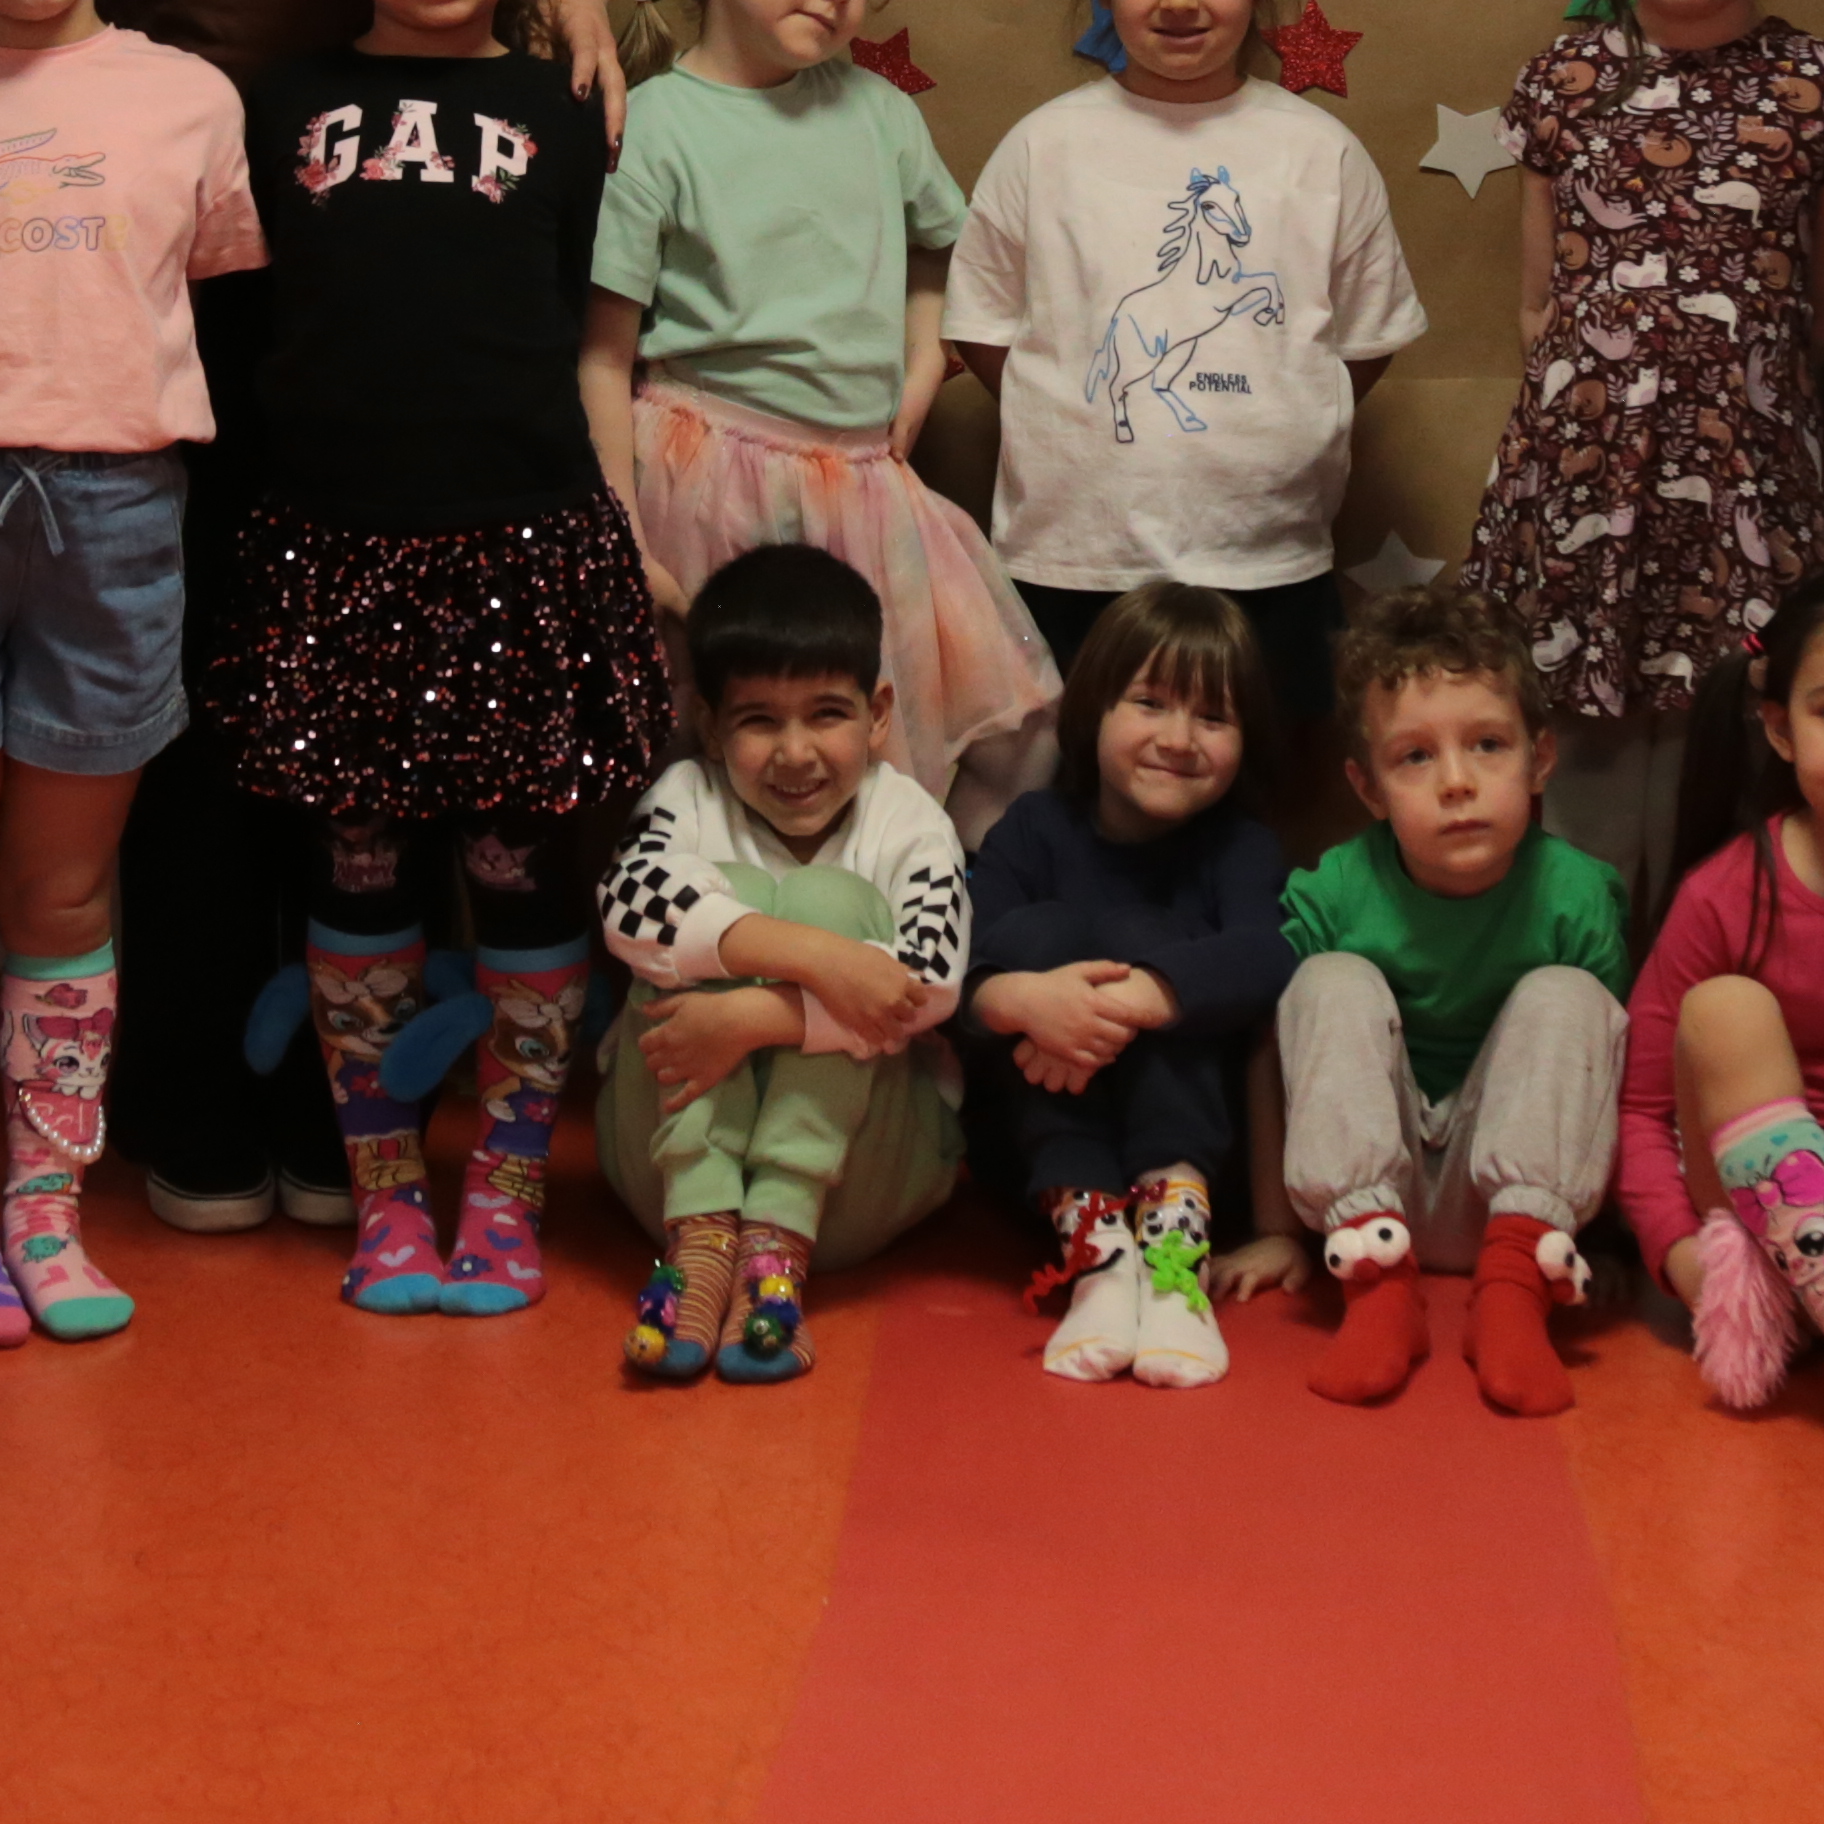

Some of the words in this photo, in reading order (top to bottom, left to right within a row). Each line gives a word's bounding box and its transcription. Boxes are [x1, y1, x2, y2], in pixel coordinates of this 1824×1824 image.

[298, 99, 534, 194] GAP
[1196, 372, 1247, 385] ENDLESS
[1189, 380, 1252, 394] POTENTIAL
